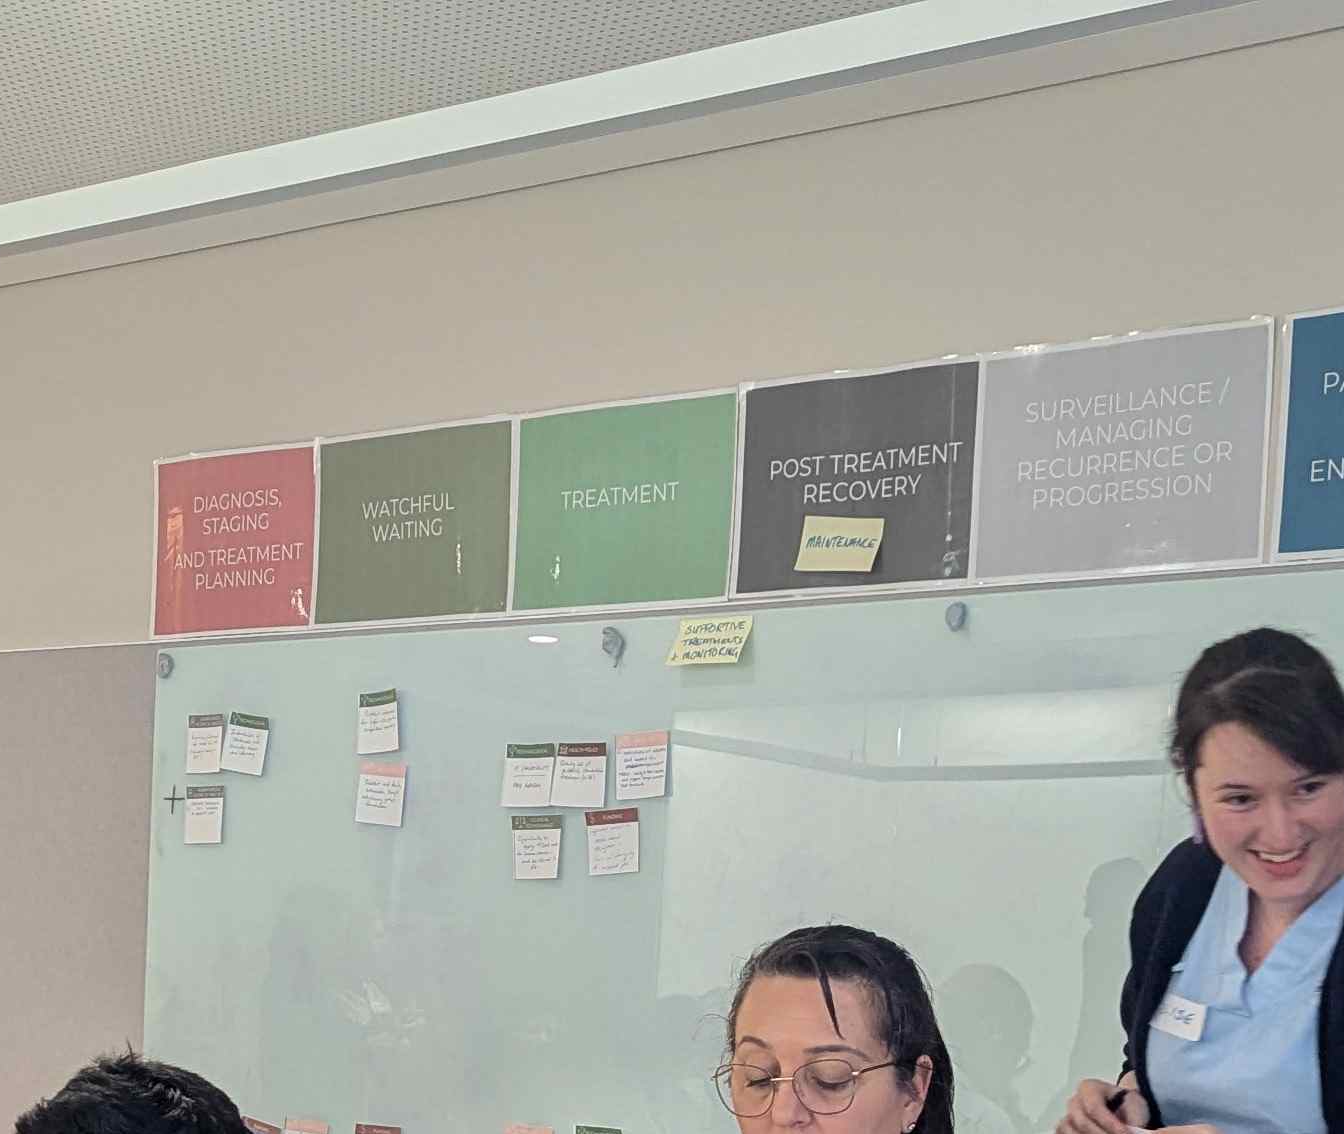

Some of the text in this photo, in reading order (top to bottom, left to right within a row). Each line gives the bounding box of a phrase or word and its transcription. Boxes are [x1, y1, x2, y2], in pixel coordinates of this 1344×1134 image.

[1025, 380, 1214, 424] SURVEILLANCE
[1055, 415, 1193, 449] MANAGING
[770, 442, 964, 480] POST TREATMENT
[1017, 441, 1233, 482] RECURRENCE OR
[192, 488, 283, 514] DIAGNOSIS,
[561, 482, 680, 510] TREATMENT
[803, 474, 923, 505] RECOVERY
[1032, 473, 1214, 510] PROGRESSION
[361, 493, 455, 521] WATCHFUL
[202, 512, 270, 535] STAGING
[371, 519, 443, 542] WAITING
[173, 542, 304, 570] AND TREATMENT
[194, 568, 276, 590] PLANNING
